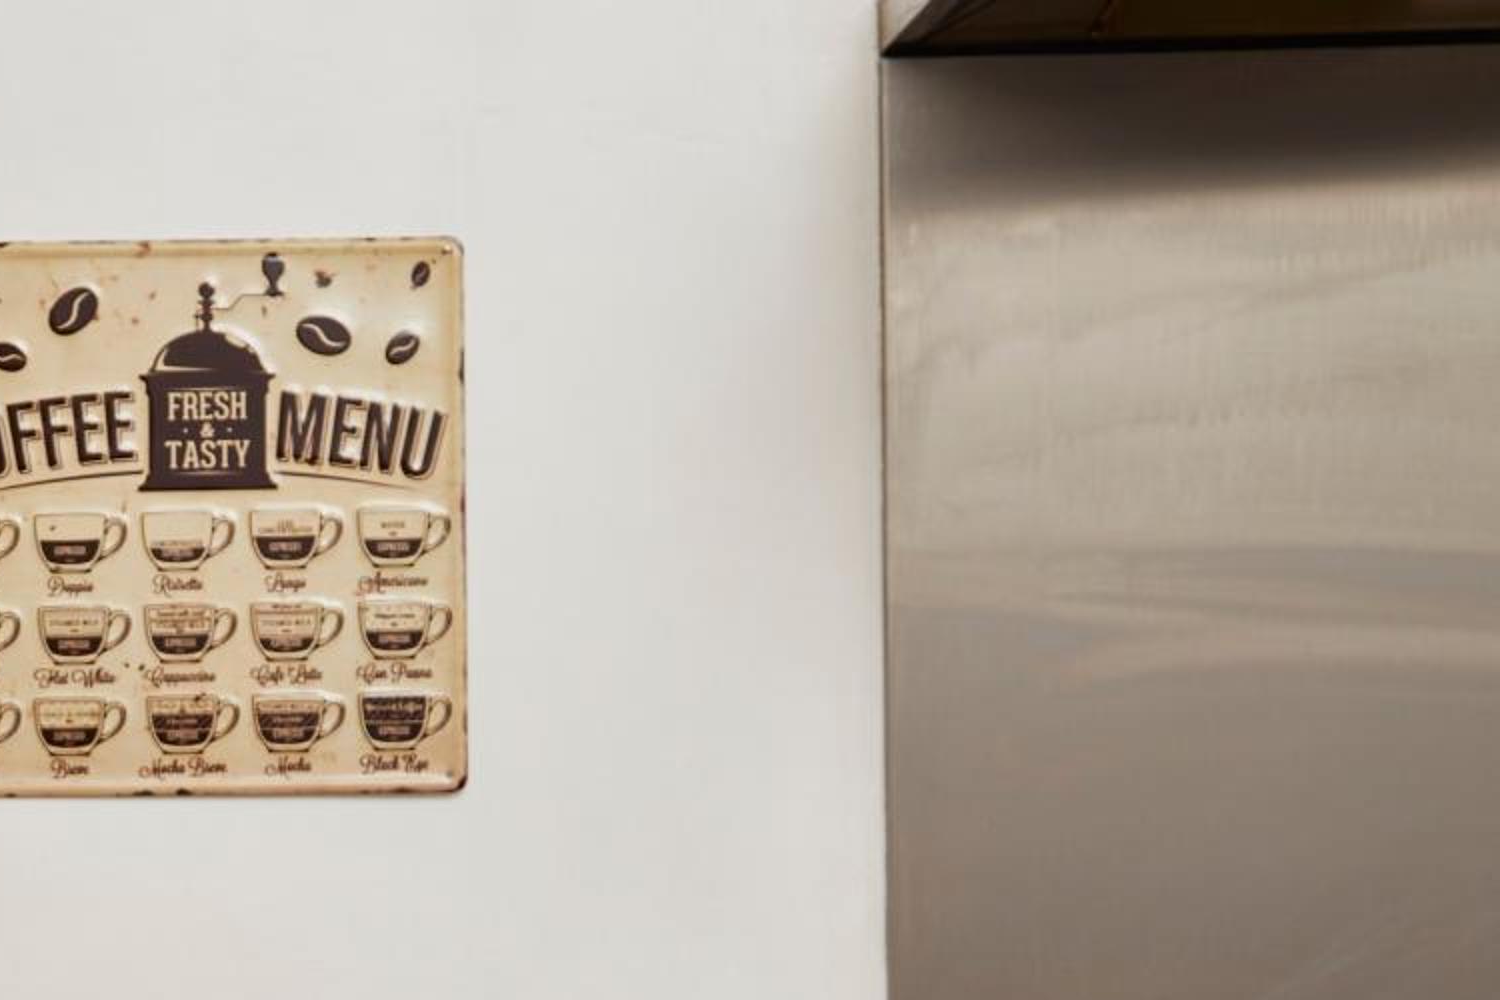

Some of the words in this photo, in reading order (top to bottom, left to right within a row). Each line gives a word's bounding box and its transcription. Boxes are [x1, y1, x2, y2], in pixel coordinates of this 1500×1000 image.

[167, 391, 248, 421] FRESH
[276, 389, 448, 480] MENU
[165, 439, 251, 470] TASTY
